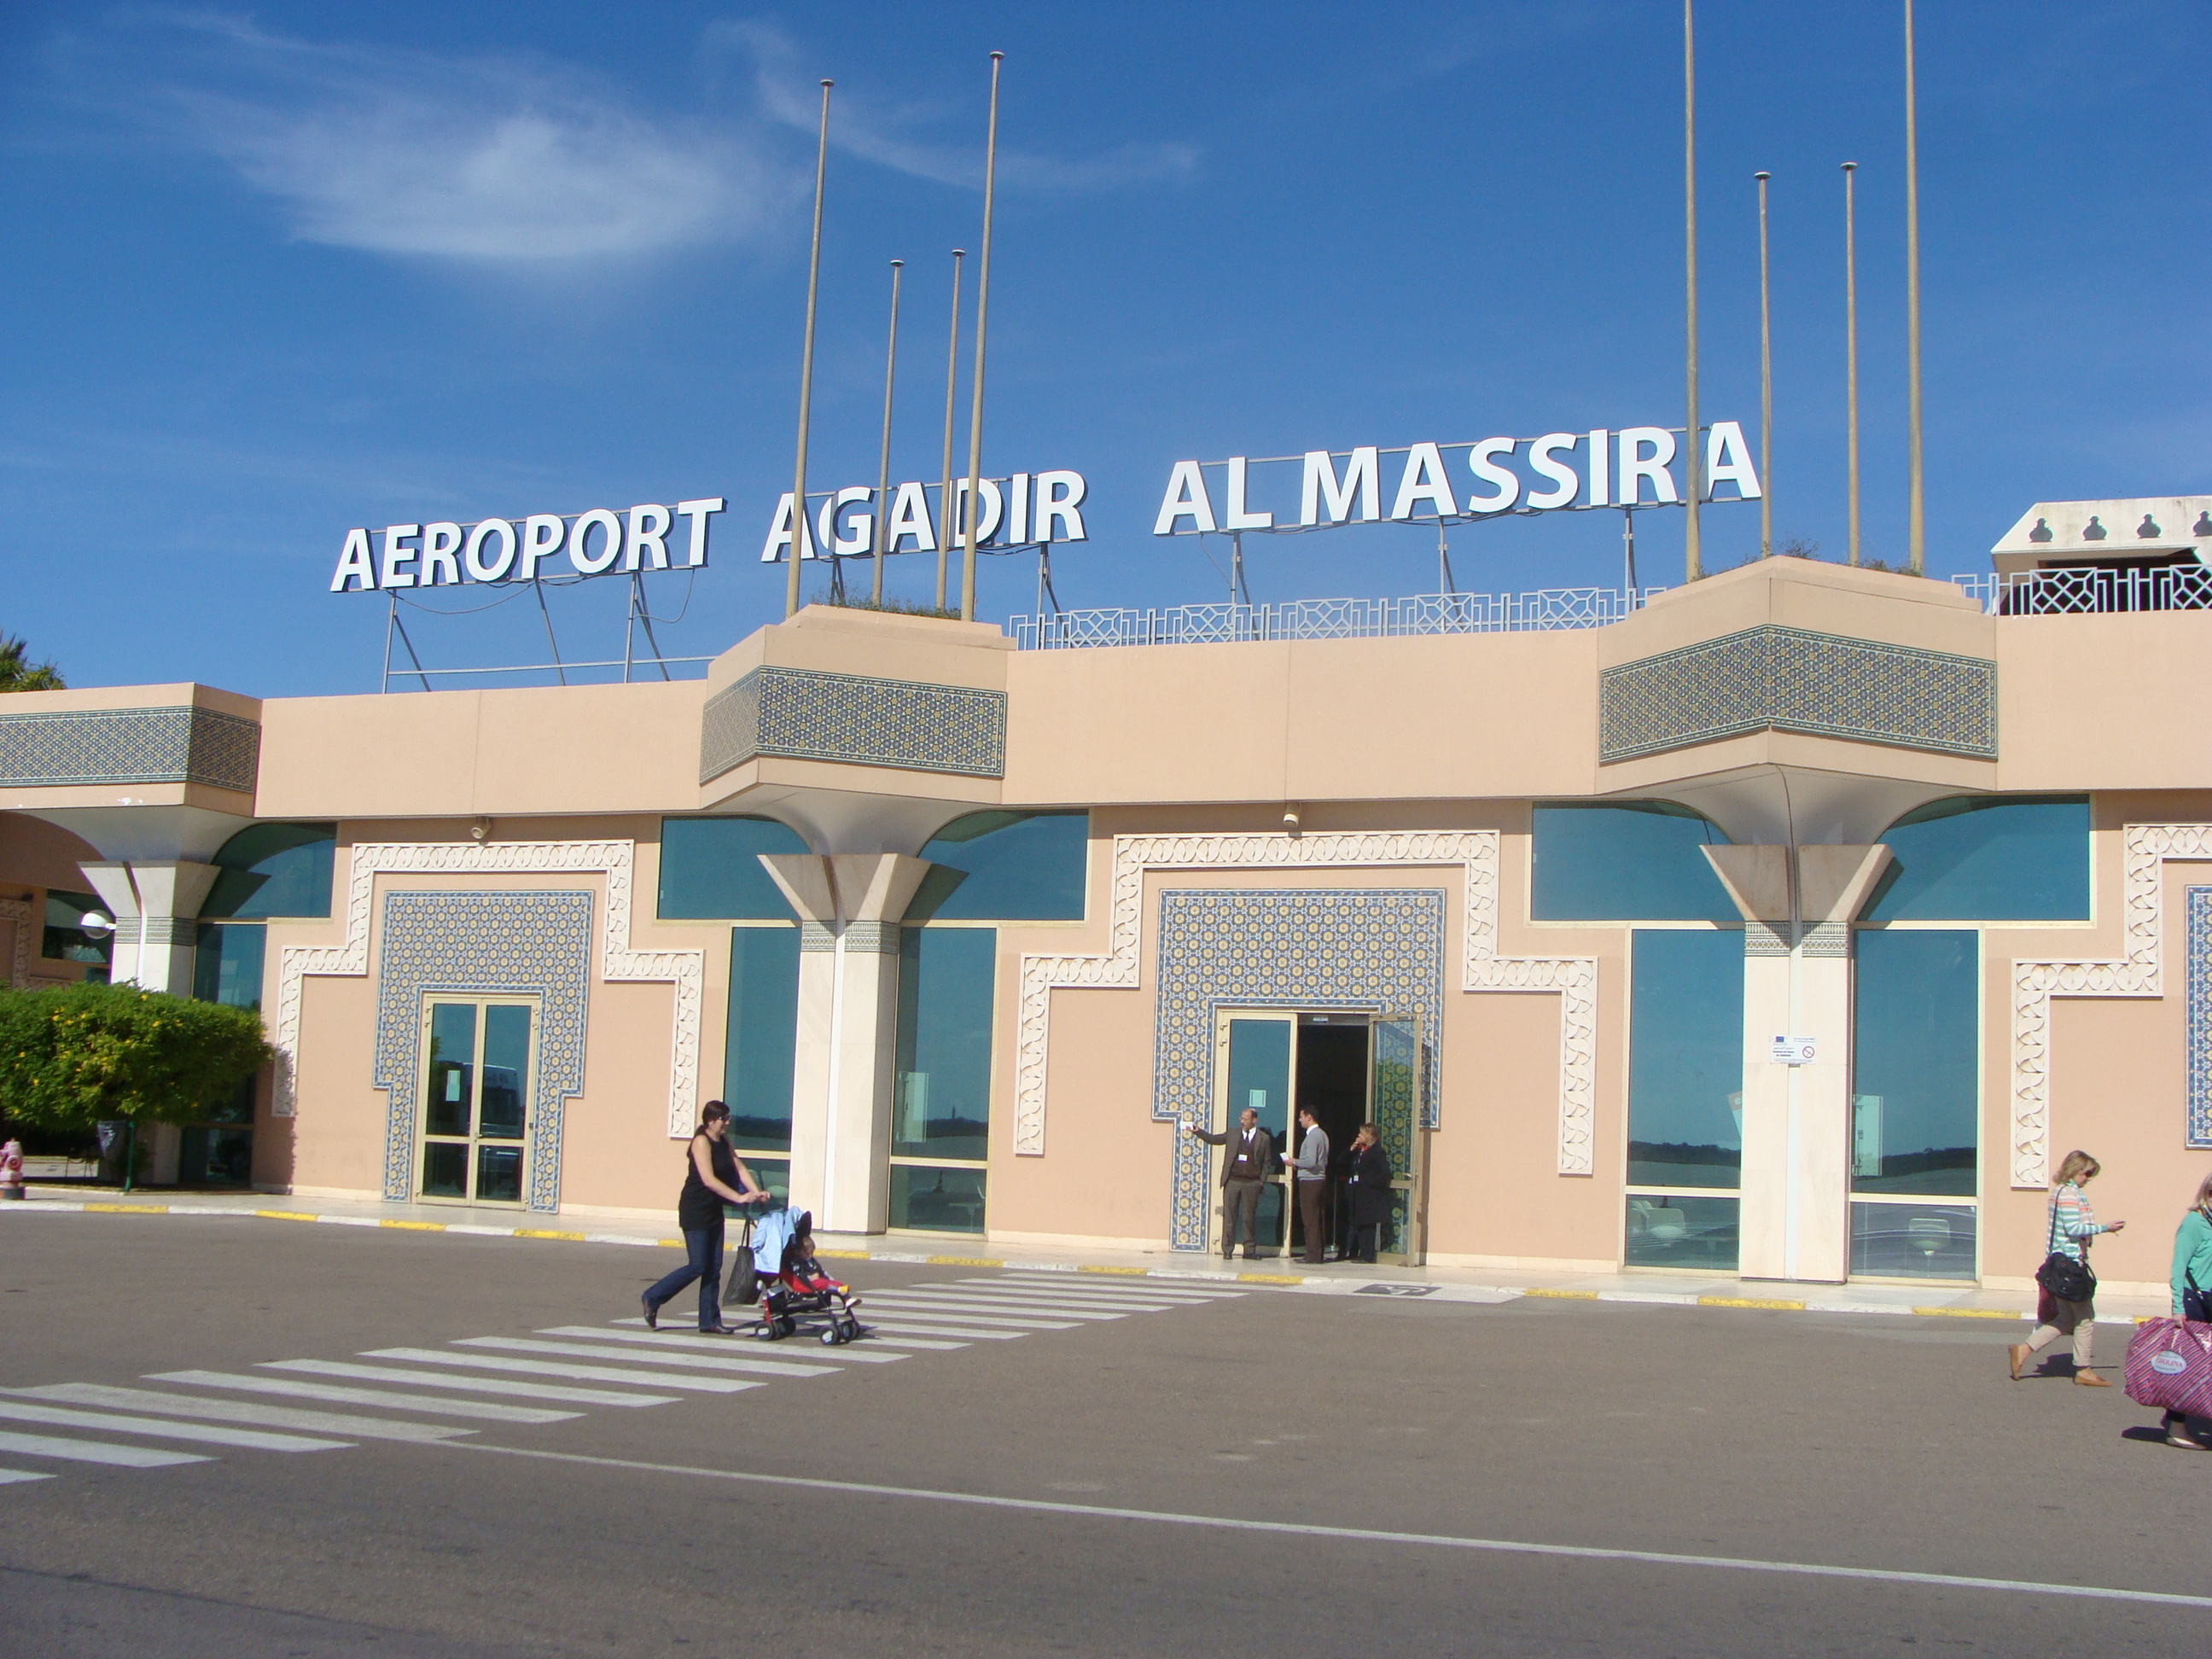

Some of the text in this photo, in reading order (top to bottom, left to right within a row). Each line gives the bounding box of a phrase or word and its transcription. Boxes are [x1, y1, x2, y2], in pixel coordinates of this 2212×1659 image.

[330, 421, 1763, 592] AEROPORT AGADIR AL MASSIRA
